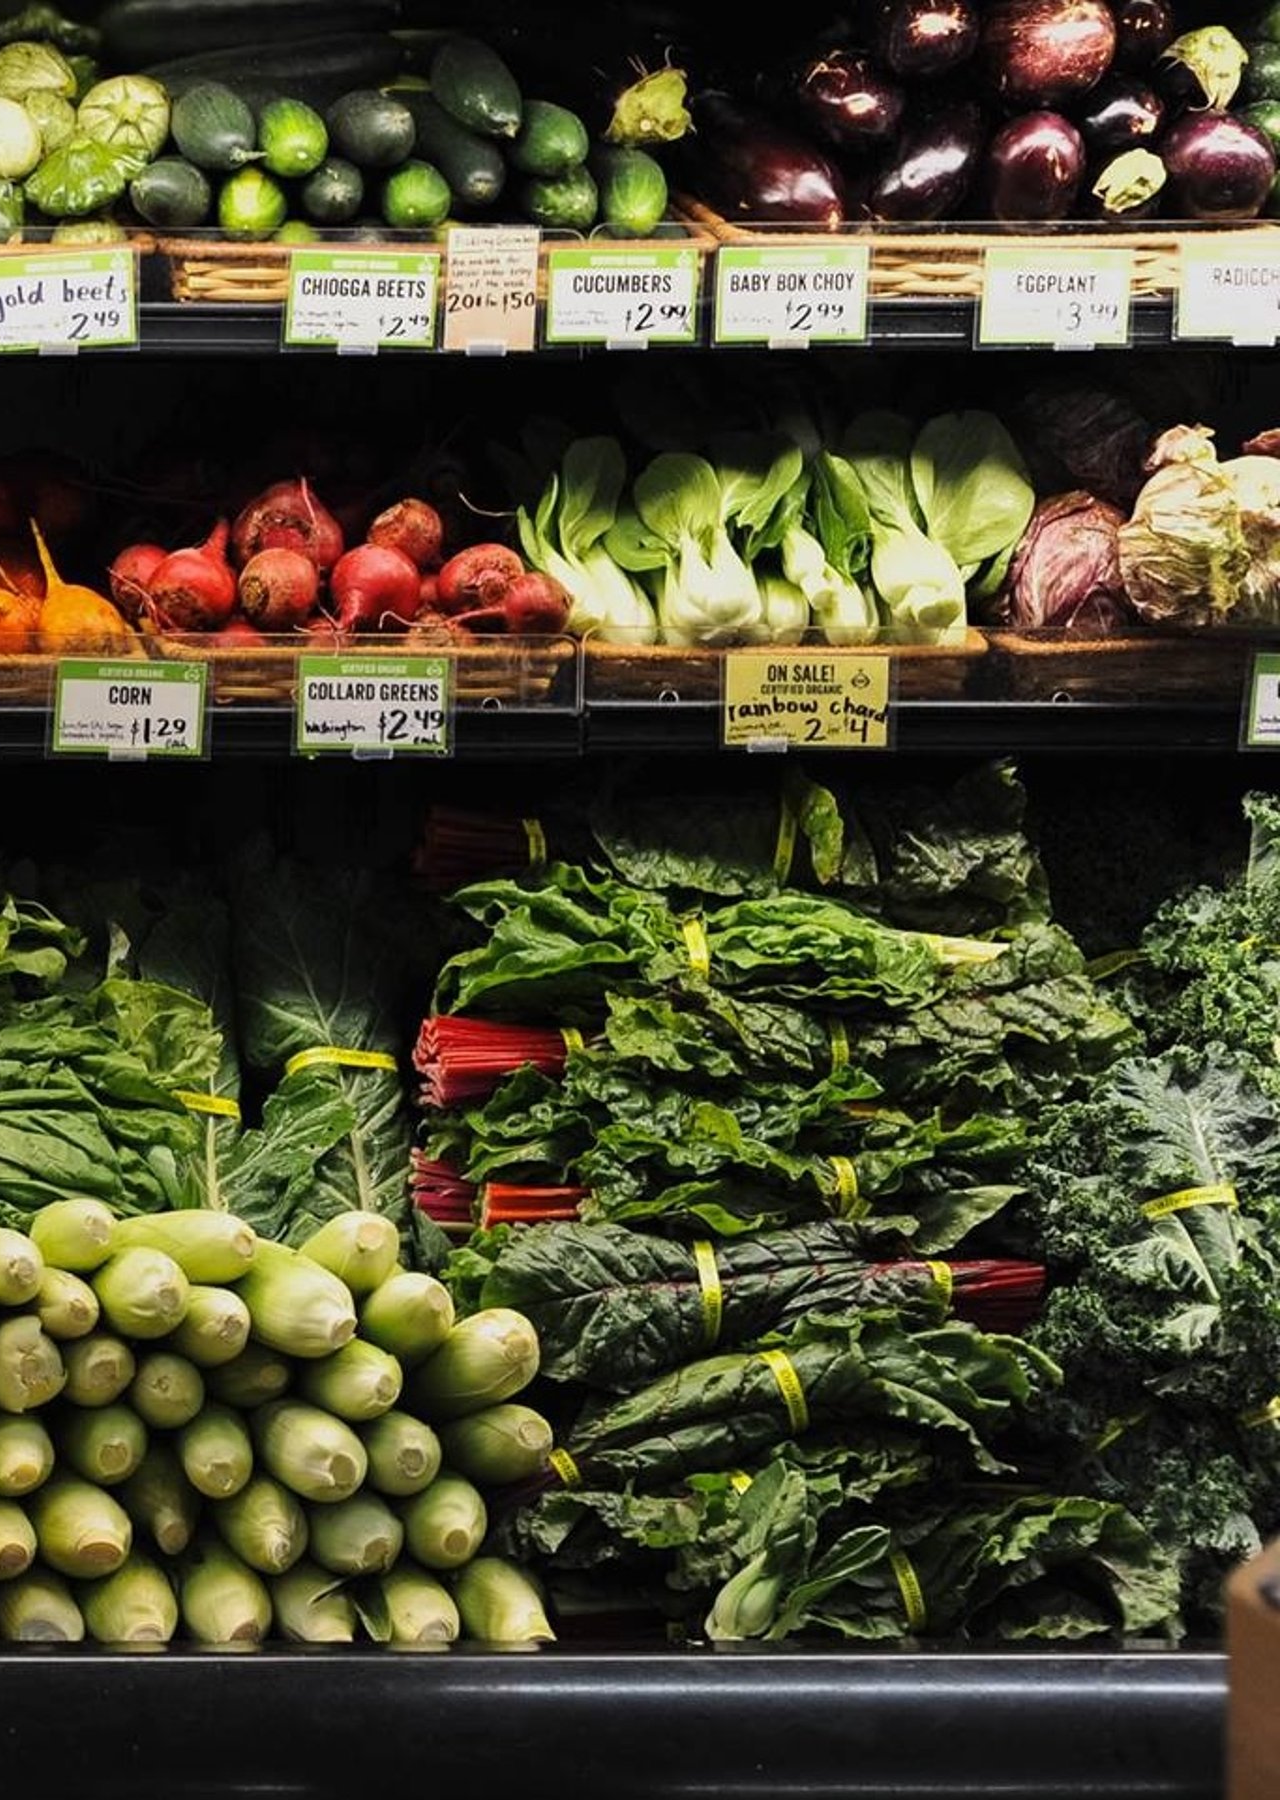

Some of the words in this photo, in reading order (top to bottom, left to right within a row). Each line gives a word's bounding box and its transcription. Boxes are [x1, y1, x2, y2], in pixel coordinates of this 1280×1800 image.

[62, 275, 127, 304] beets
[302, 277, 371, 297] CHIOGGA
[376, 279, 426, 299] BEETS
[572, 274, 673, 294] CUCUMBERS
[729, 273, 770, 292] BABY
[777, 273, 808, 292] BOK
[813, 273, 855, 292] CHOY
[1016, 274, 1096, 294] EGGPLANT
[767, 664, 787, 682] ON
[793, 664, 835, 683] SALE!
[109, 686, 152, 705] CORN
[308, 682, 375, 701] COLLARD
[380, 684, 439, 702] GREENS
[760, 684, 804, 695] CERTIFIED
[805, 684, 843, 695] ORGANIC
[728, 695, 818, 722] rainbow
[830, 696, 889, 722] chard
[804, 717, 826, 742] 2
